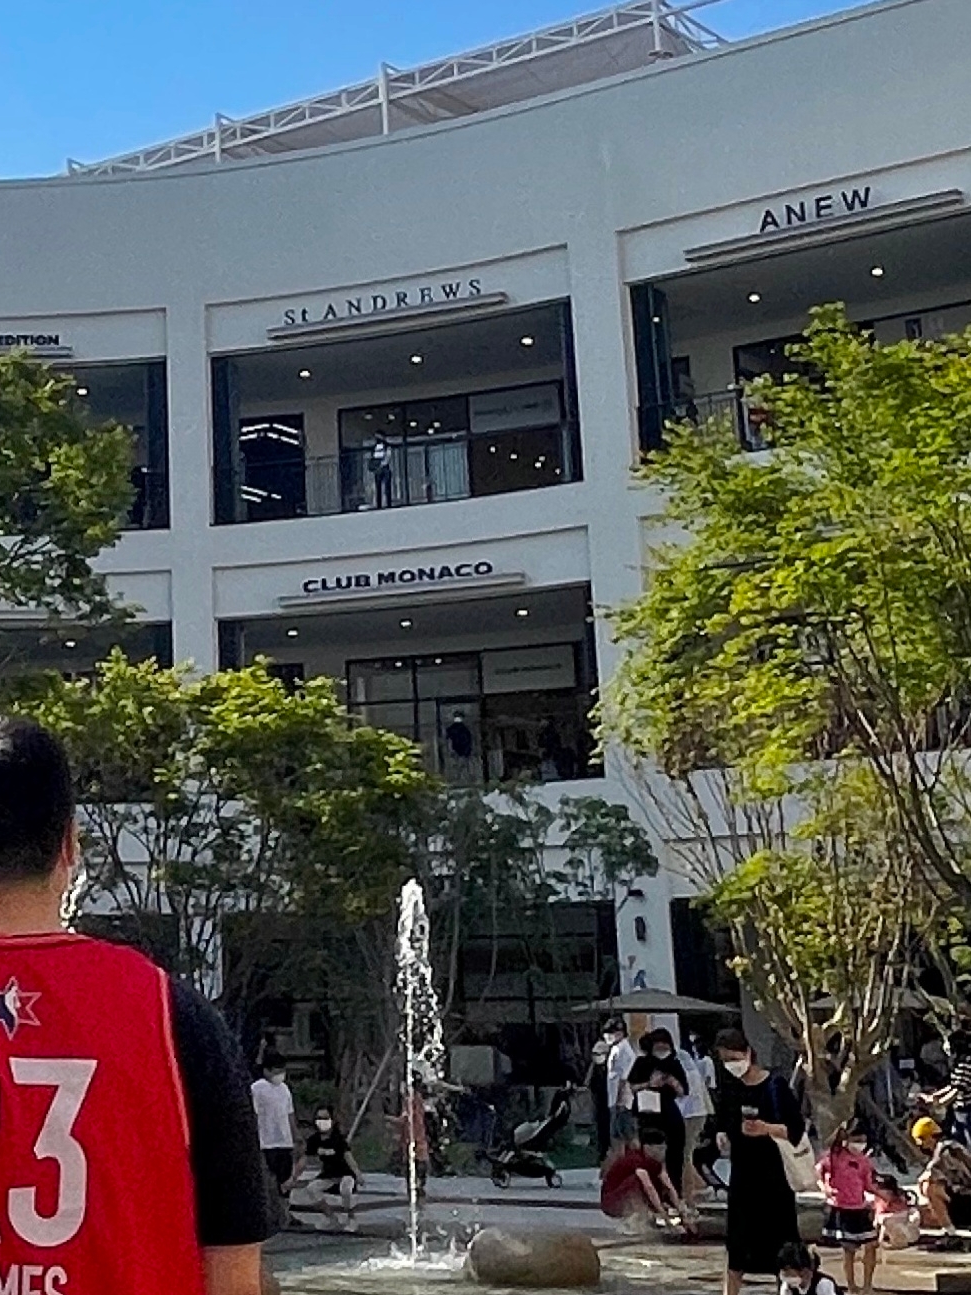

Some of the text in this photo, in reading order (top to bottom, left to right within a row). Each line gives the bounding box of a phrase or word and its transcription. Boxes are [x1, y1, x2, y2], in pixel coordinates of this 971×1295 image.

[759, 186, 871, 233] ANEW
[284, 278, 482, 326] St ANDREWS
[302, 561, 494, 594] CLUB MONACO
